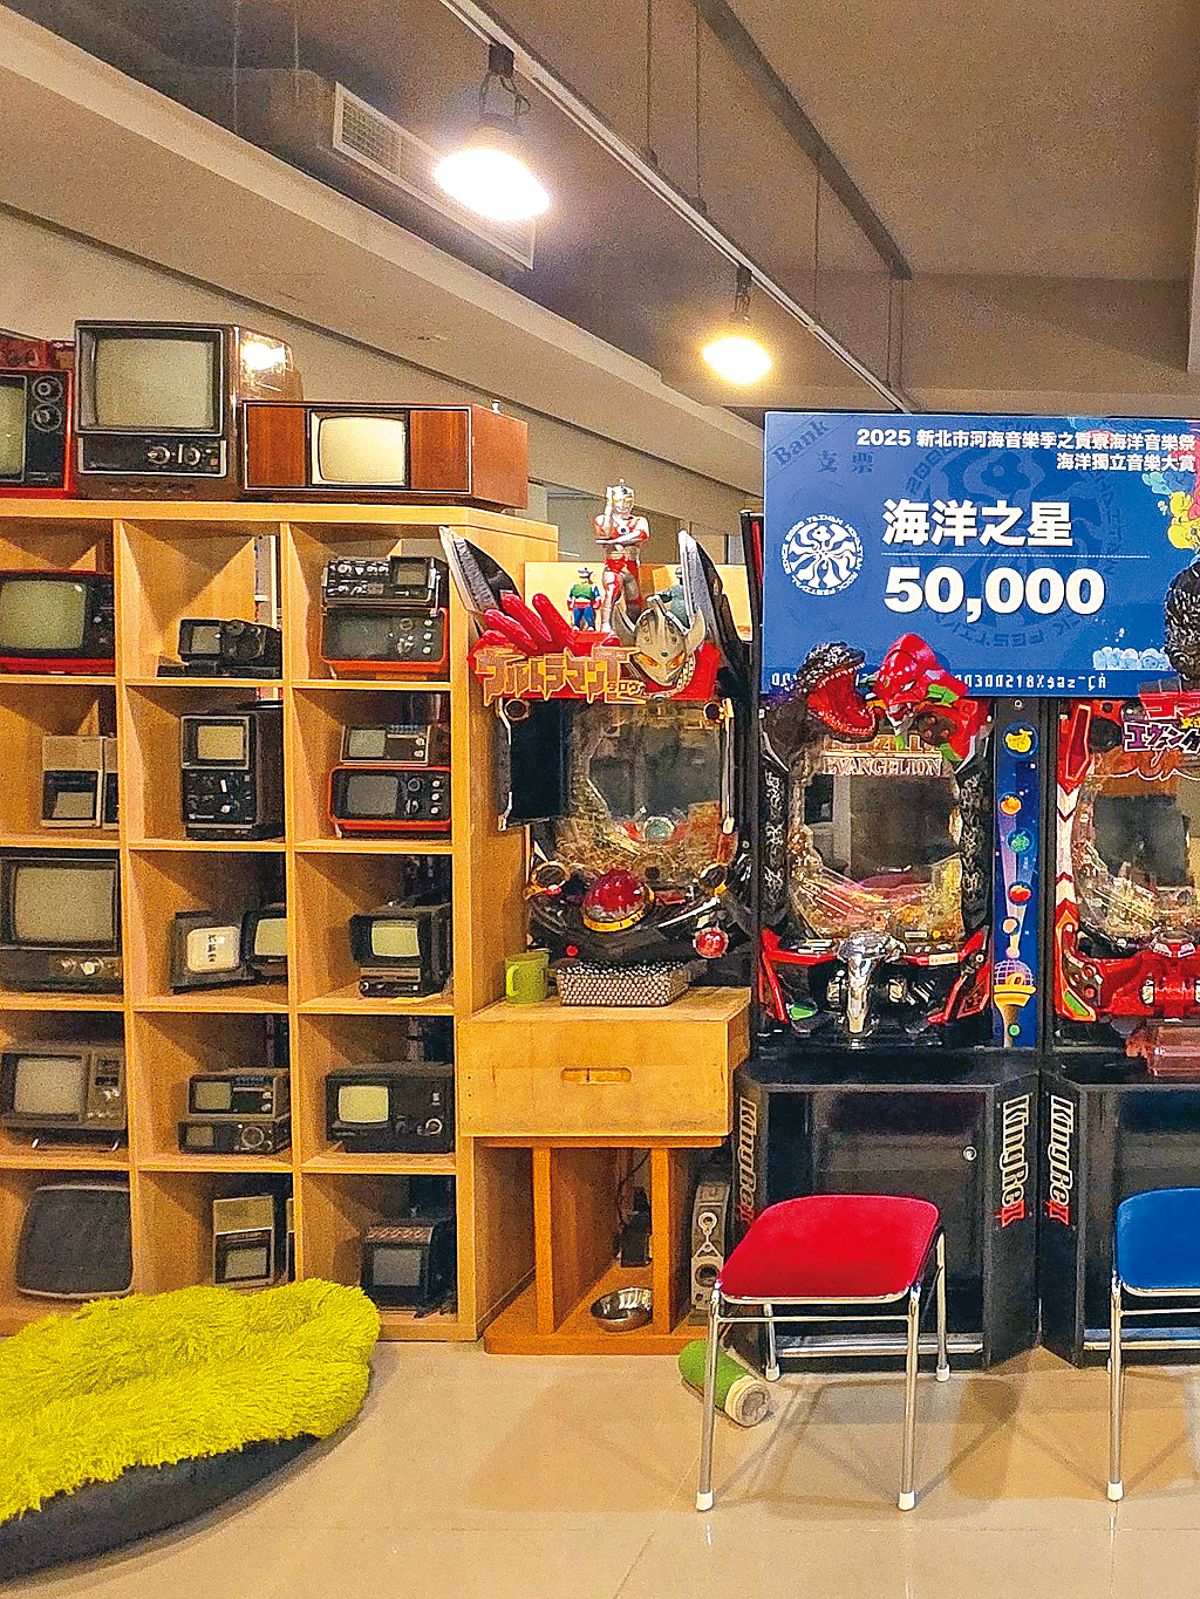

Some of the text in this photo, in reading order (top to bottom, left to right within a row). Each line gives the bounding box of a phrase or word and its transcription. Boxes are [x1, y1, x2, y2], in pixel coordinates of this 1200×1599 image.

[772, 420, 830, 466] Bank
[856, 428, 1196, 451] 2025 新北市河海音樂季之貢寮海洋音樂祭
[1056, 452, 1196, 473] 海洋獨立音樂大賞
[882, 498, 1073, 548] 海洋之星
[883, 565, 1106, 624] 50,000
[822, 756, 942, 777] EVANGELION
